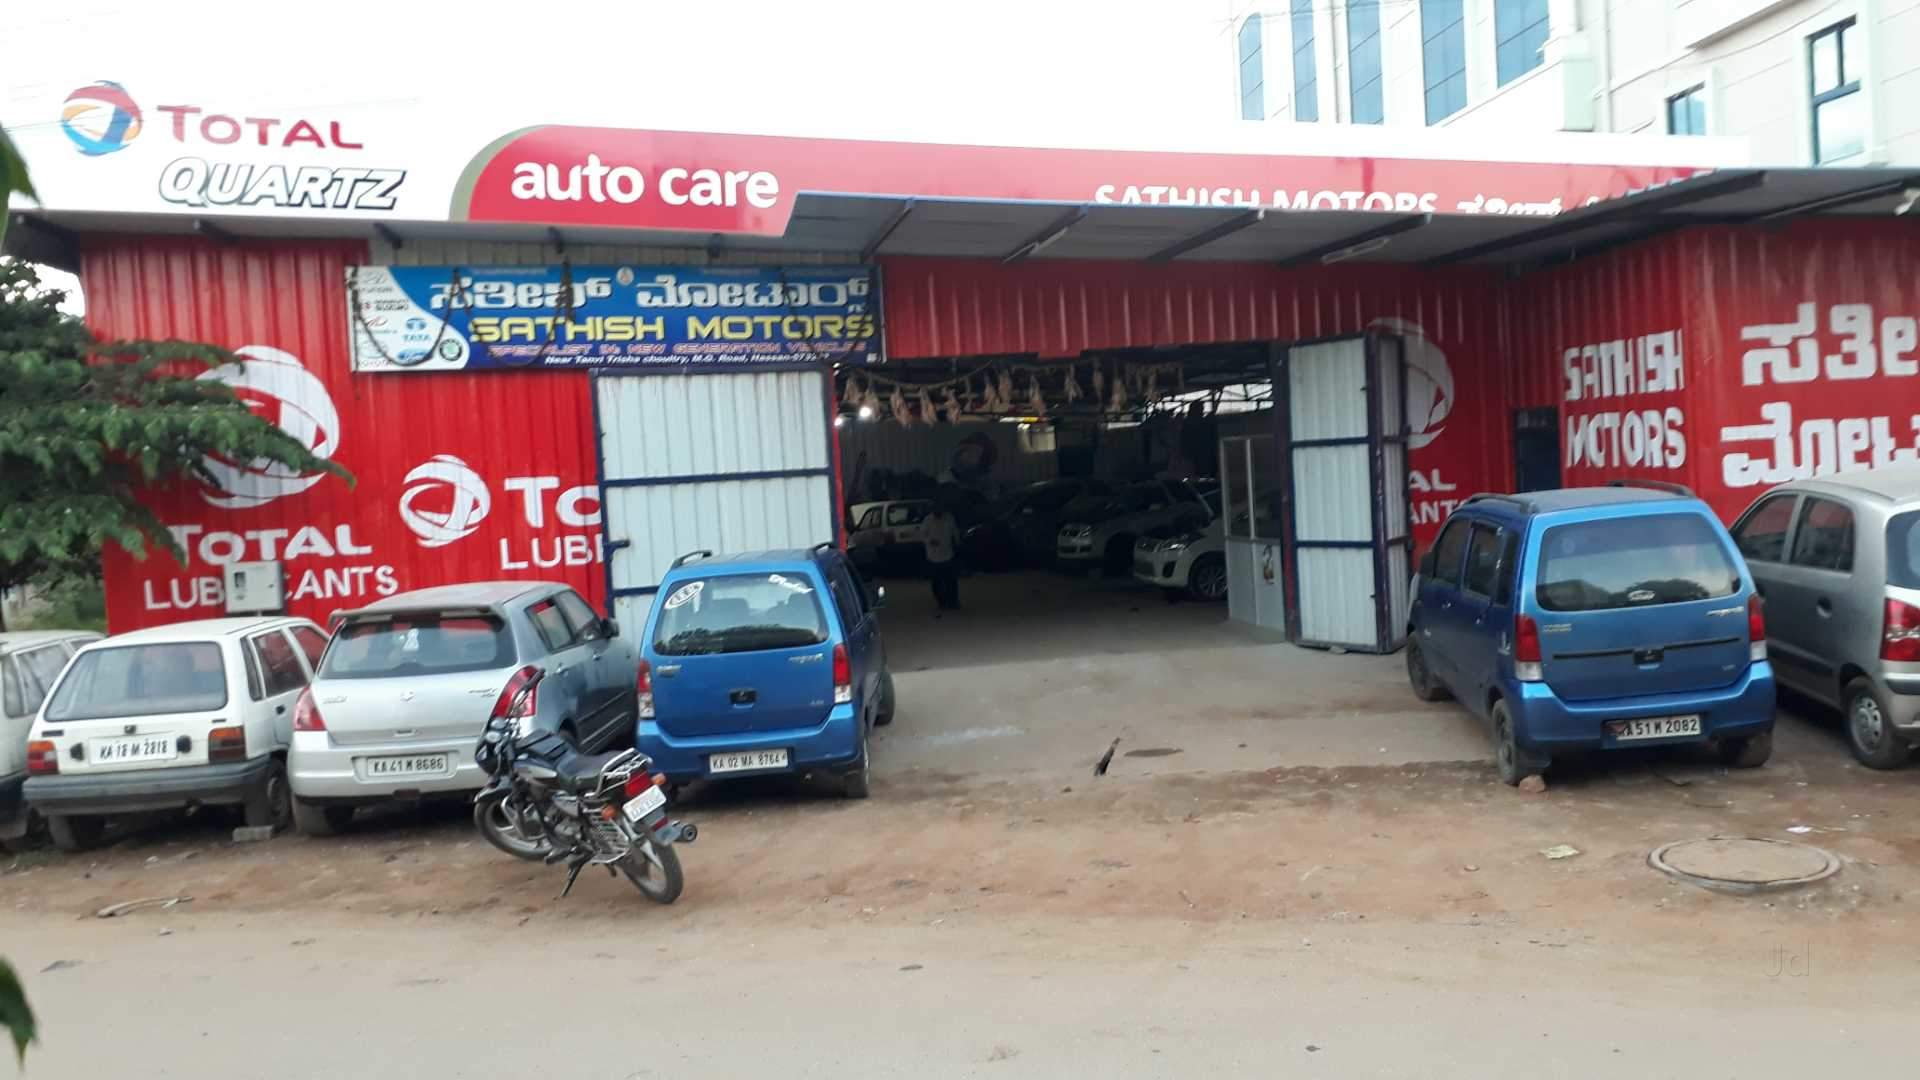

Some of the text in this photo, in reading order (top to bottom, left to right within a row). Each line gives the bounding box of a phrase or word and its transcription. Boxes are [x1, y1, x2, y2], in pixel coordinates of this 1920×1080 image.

[157, 105, 363, 149] TOTAL
[158, 156, 407, 210] QUARTZ
[510, 153, 779, 208] auto care
[469, 314, 875, 342] SATHISH MOTORS
[1565, 329, 1684, 400] SATHISH
[504, 476, 601, 528] TO
[1408, 468, 1456, 492] AL
[168, 523, 373, 565] TOTAL
[1666, 718, 1698, 734] 2082
